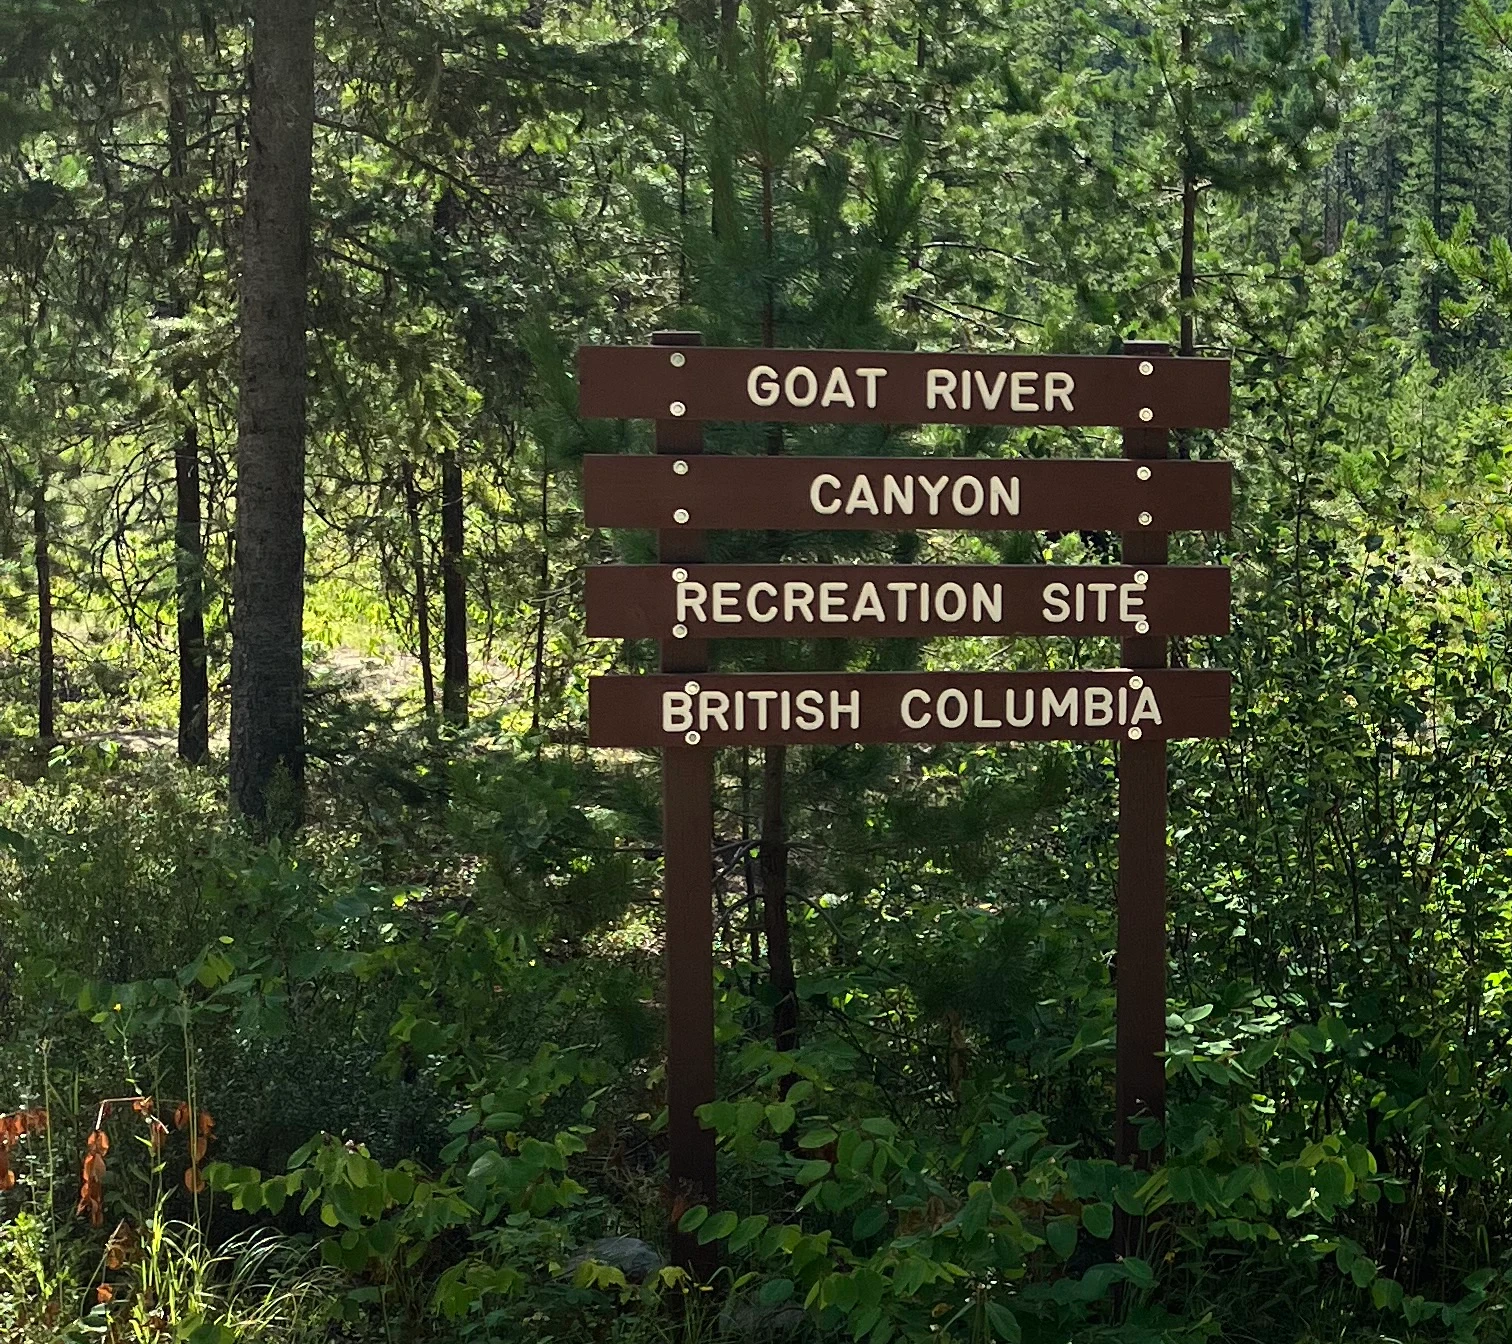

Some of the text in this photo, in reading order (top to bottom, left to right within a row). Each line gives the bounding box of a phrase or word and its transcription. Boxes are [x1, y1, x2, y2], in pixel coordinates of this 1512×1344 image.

[746, 364, 1076, 413] GOAT RIVER
[809, 473, 1021, 516] CANYON
[676, 580, 1147, 623] RECREATION SITE
[662, 686, 1163, 733] BRITISH COLUMBIA
